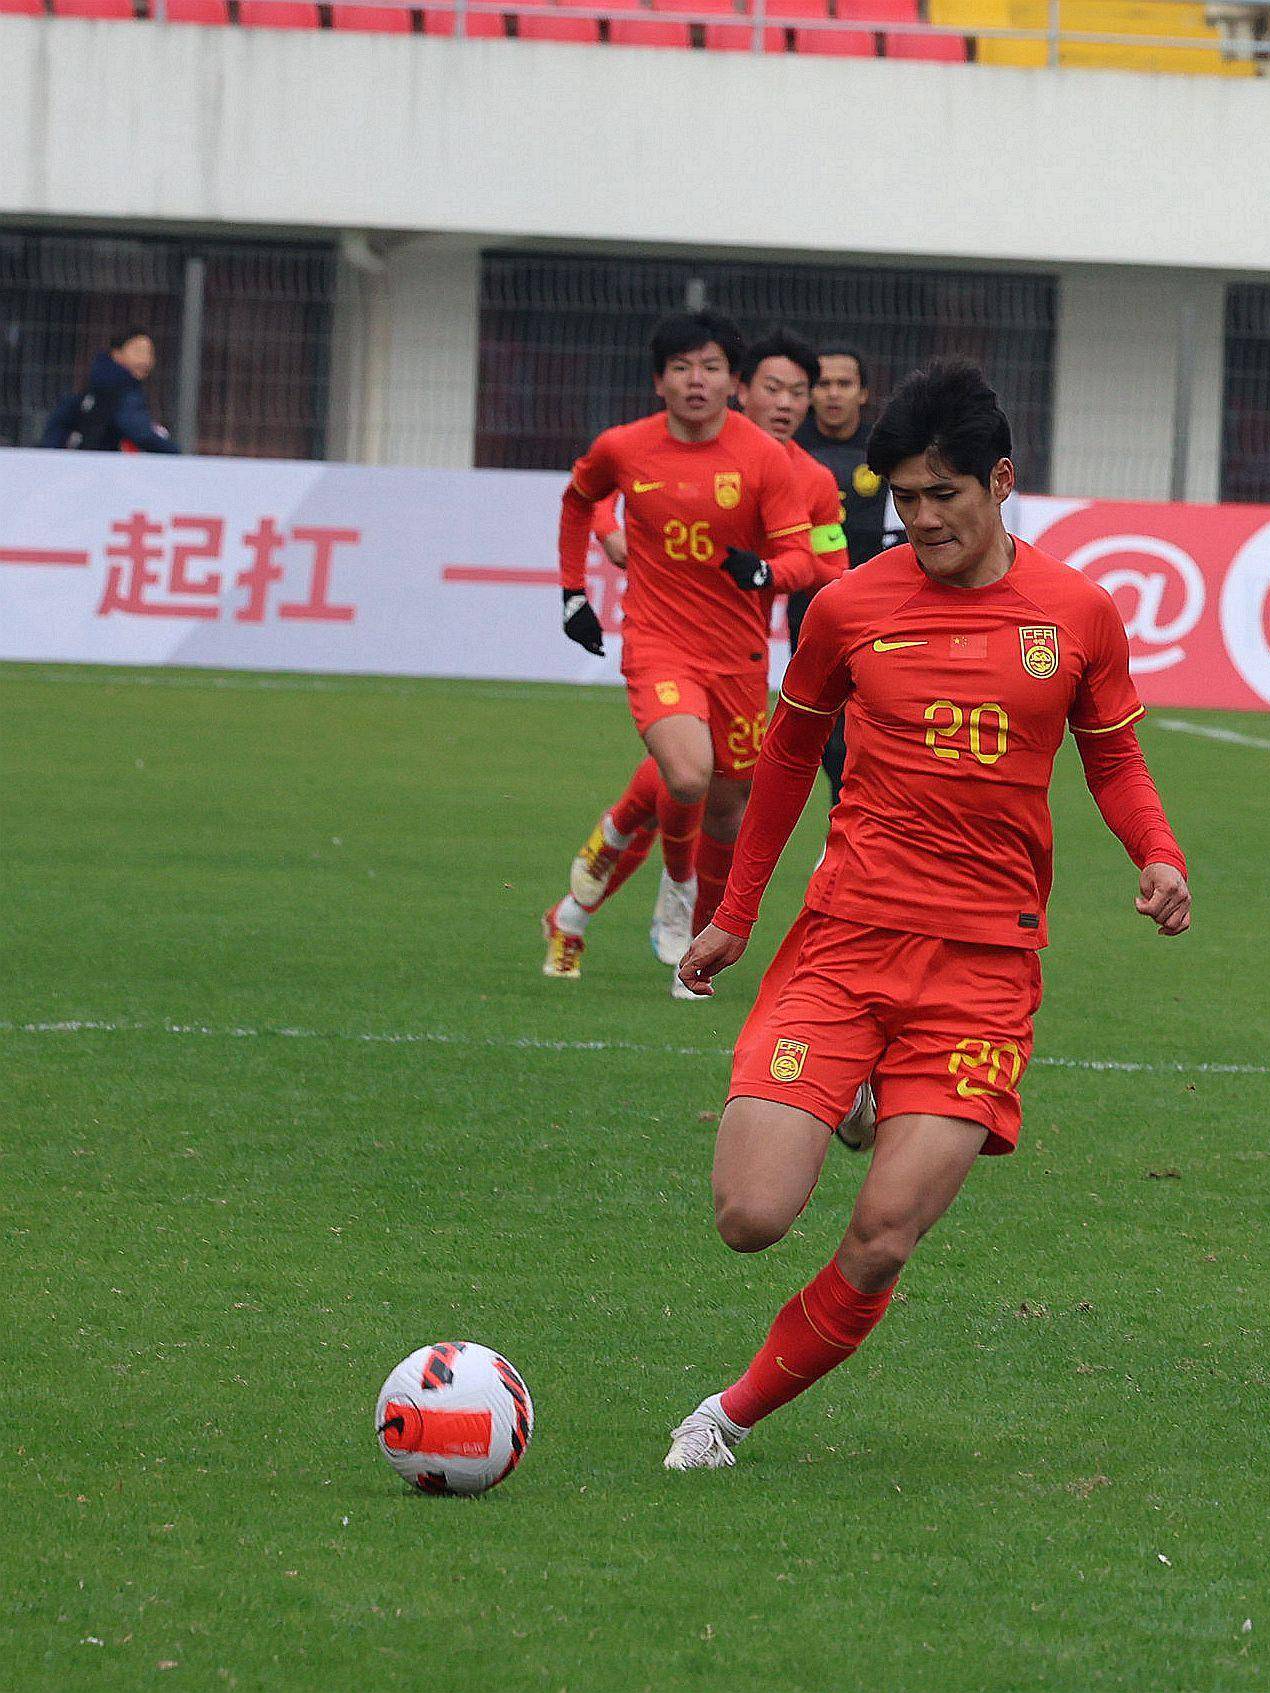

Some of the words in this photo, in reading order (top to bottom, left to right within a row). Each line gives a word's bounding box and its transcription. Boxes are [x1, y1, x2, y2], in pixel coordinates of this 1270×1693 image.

[663, 519, 714, 561] 26
[0, 512, 361, 622] 一起扛
[1023, 629, 1054, 640] CFA
[923, 699, 1009, 765] 20
[947, 1038, 1021, 1091] 20
